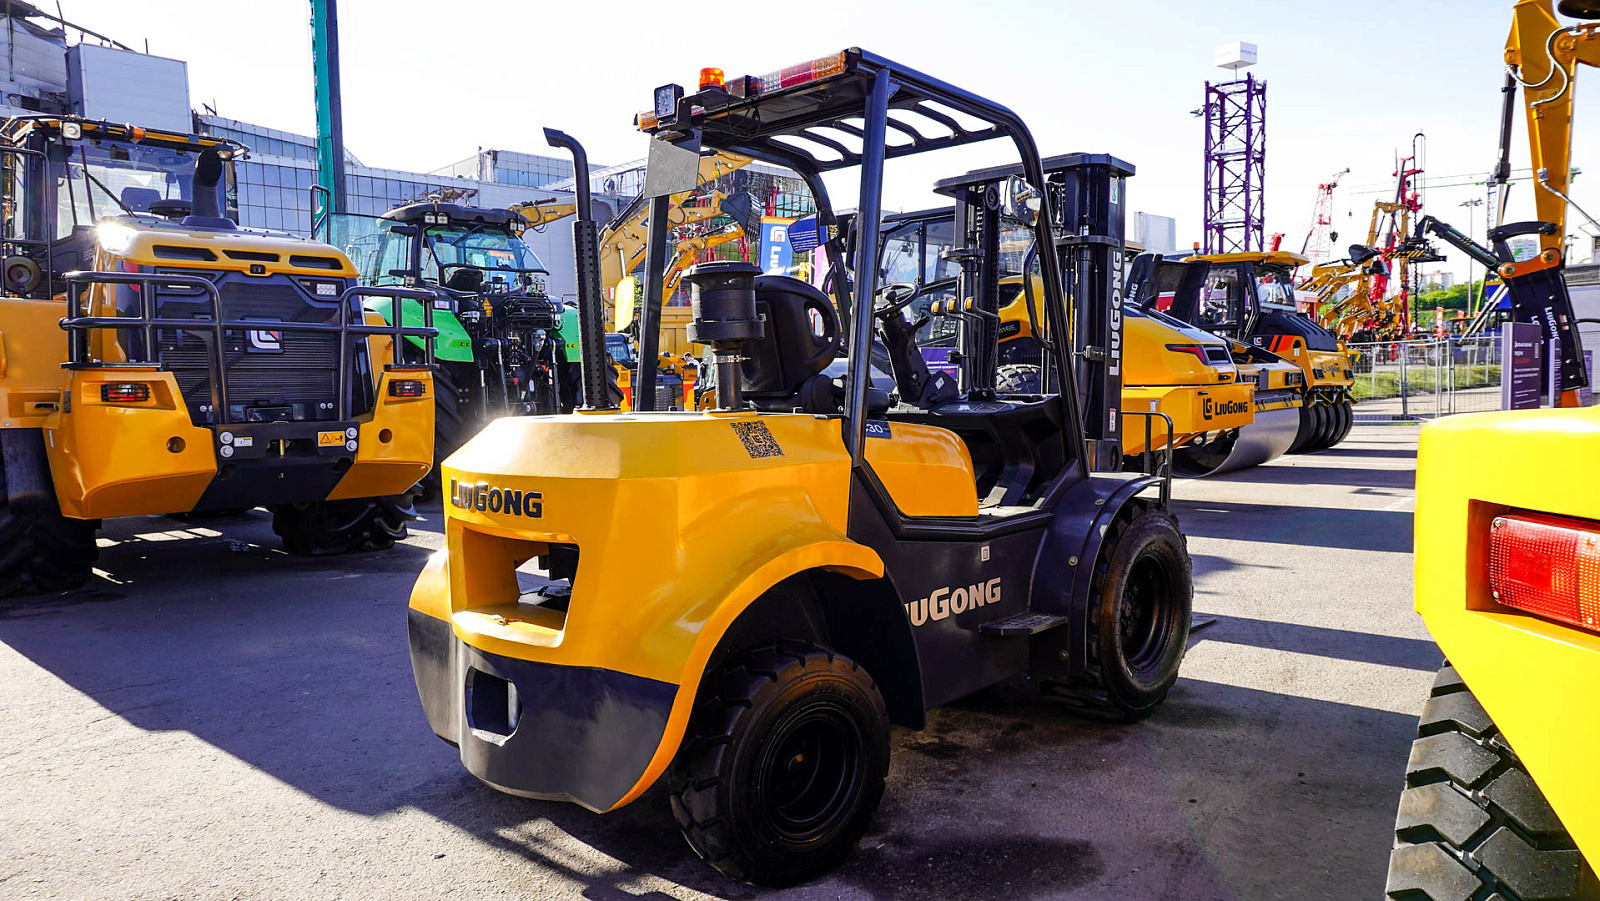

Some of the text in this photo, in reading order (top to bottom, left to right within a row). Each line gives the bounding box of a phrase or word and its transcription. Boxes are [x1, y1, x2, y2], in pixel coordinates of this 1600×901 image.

[770, 246, 782, 269] LIU
[1109, 251, 1122, 376] LIUGONG
[1215, 400, 1248, 416] LIUGONG
[451, 477, 543, 519] LIUGONG
[904, 577, 1001, 627] UGONG
